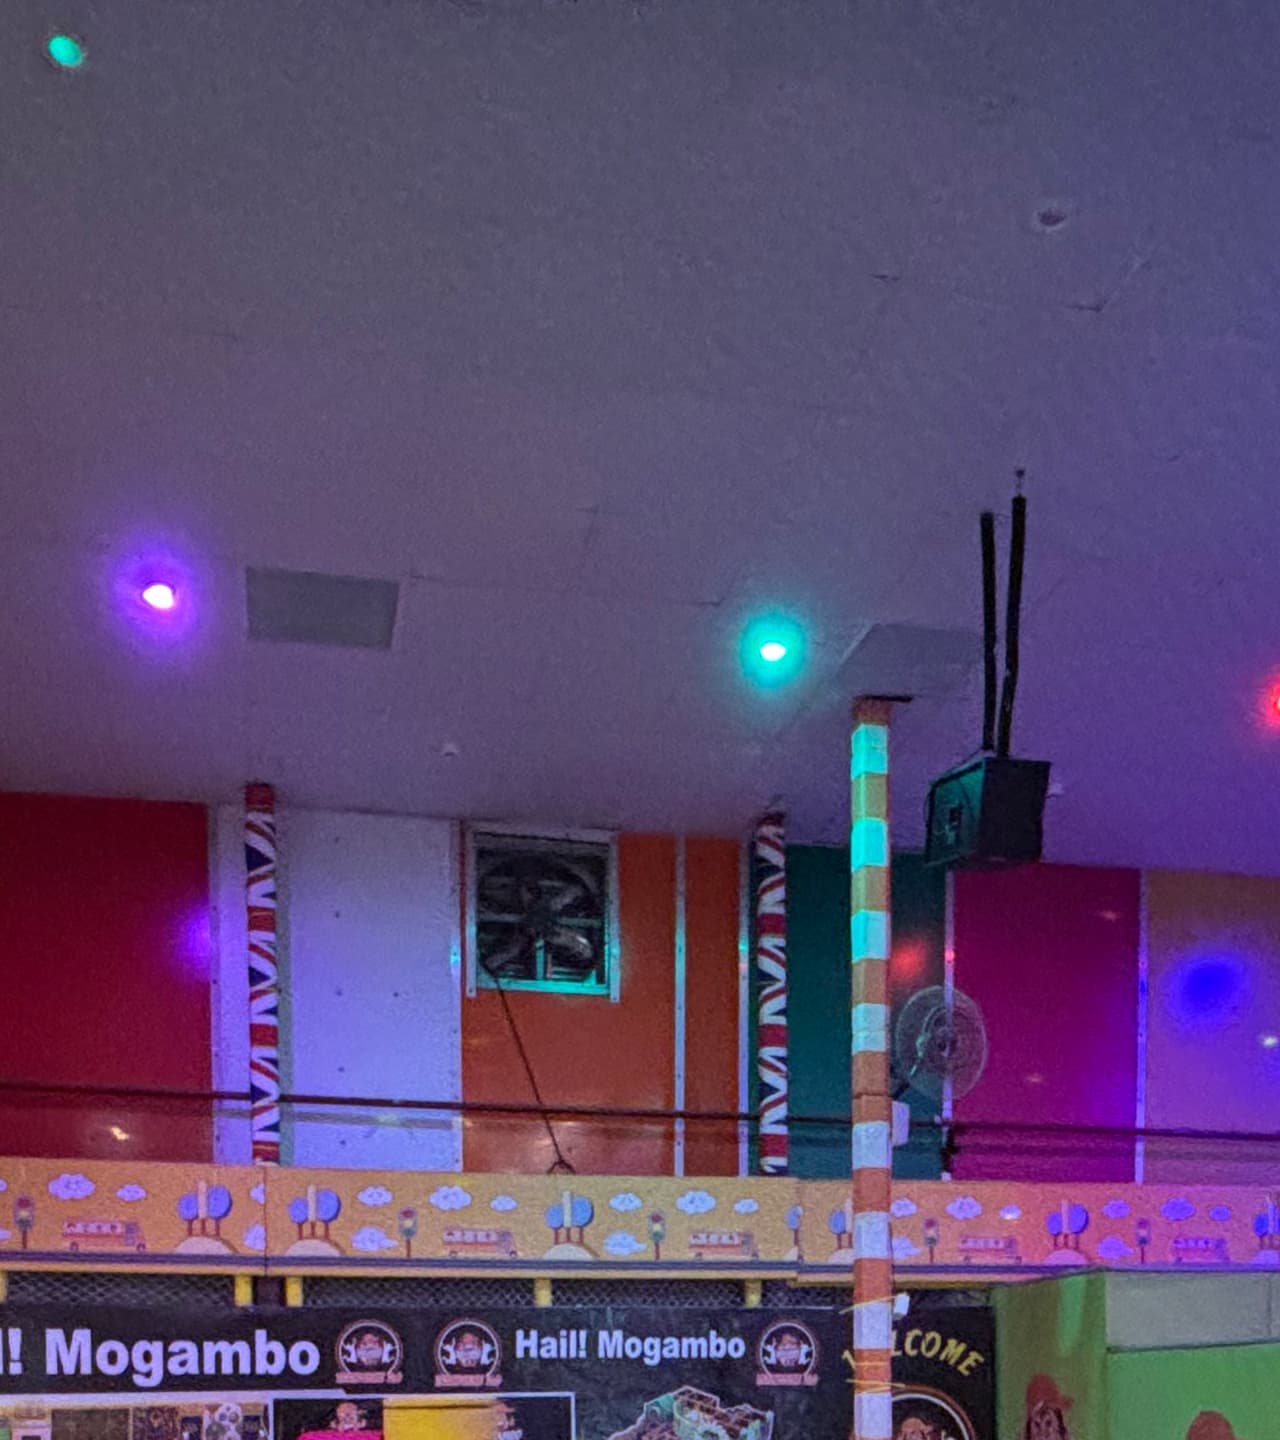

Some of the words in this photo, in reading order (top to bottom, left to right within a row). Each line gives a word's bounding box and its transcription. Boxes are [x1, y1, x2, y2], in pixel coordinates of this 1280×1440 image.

[45, 1328, 320, 1387] Mogambo
[515, 1329, 588, 1359] Hail!
[598, 1329, 746, 1366] Mogambo
[842, 1329, 984, 1376] LCOME
